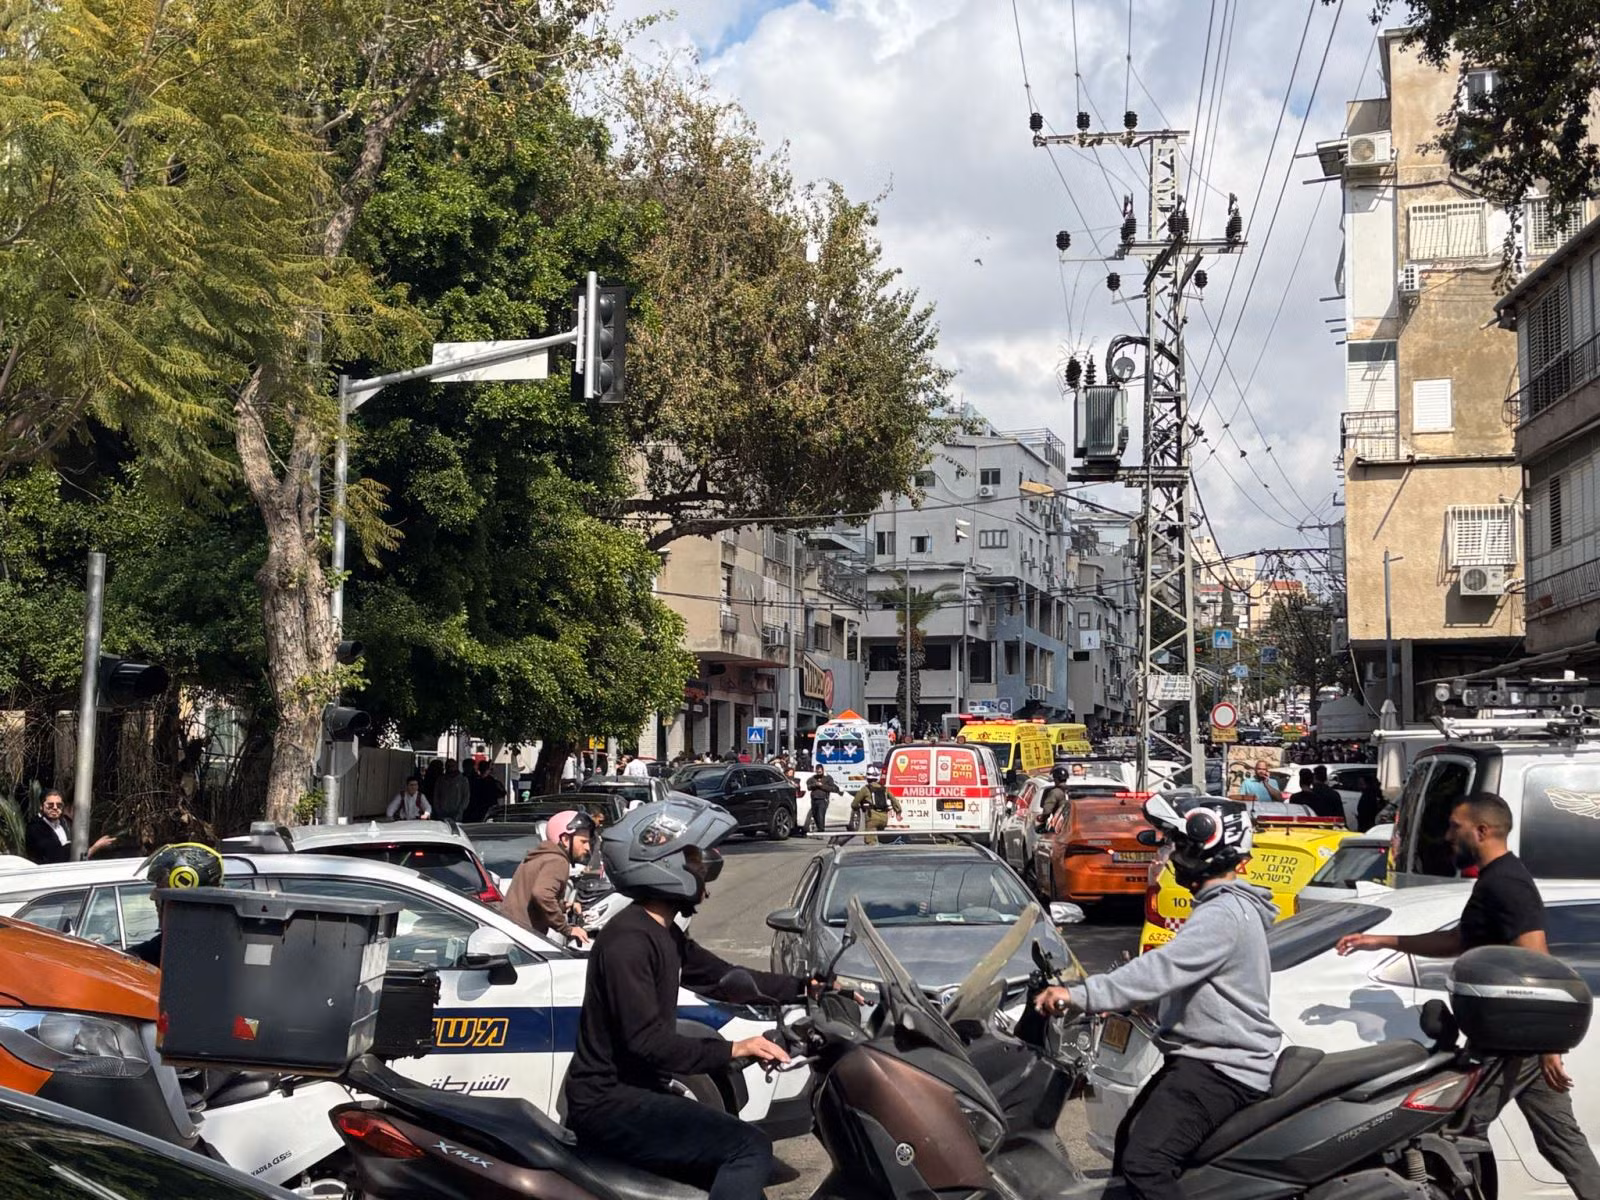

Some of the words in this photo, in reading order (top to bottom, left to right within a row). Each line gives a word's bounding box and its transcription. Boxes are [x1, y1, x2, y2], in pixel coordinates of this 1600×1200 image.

[952, 770, 972, 779] חיים
[902, 787, 967, 797] AMBULANCE
[907, 809, 930, 818] אביב
[939, 812, 955, 821] 101
[1260, 854, 1277, 863] דוד
[1278, 857, 1298, 866] מגן
[1267, 864, 1296, 874] אדום
[1250, 871, 1292, 885] בישראל
[431, 1074, 511, 1096] الشرطة
[250, 1162, 273, 1177] YADEA
